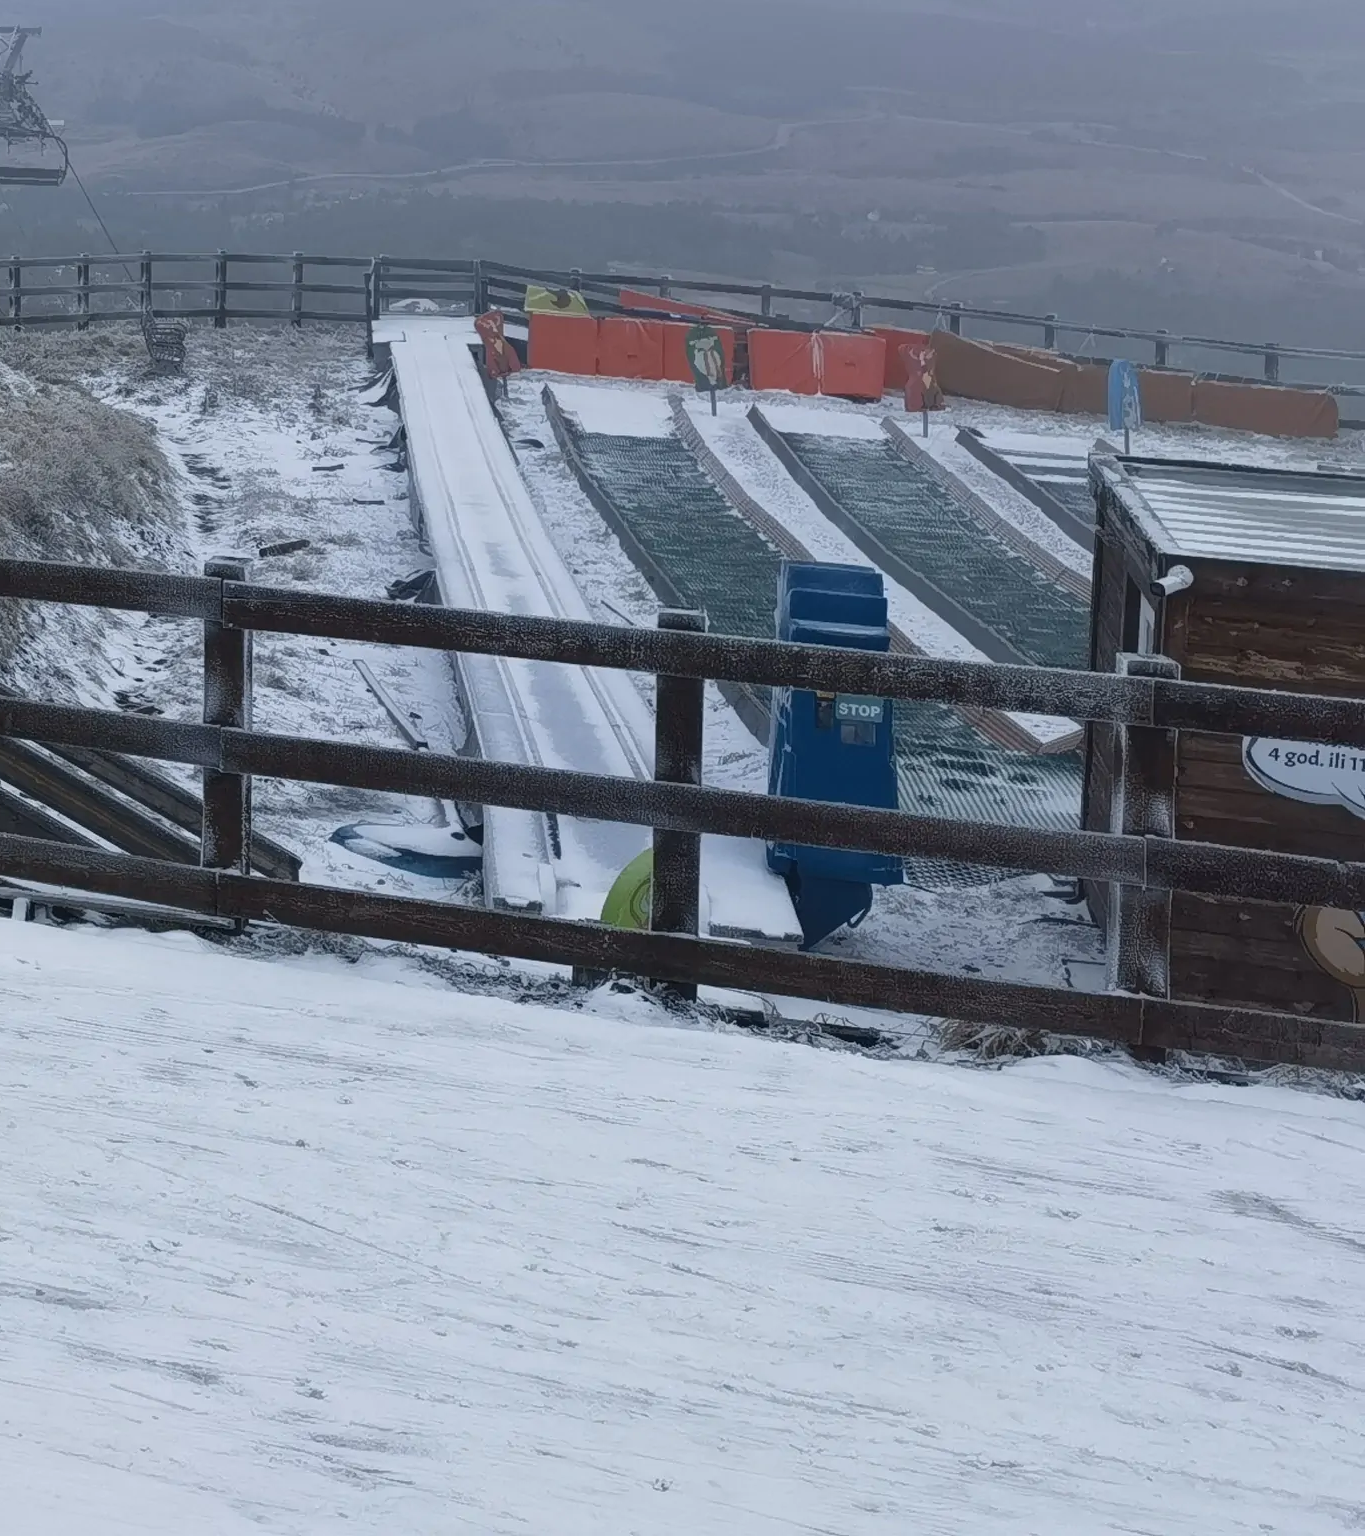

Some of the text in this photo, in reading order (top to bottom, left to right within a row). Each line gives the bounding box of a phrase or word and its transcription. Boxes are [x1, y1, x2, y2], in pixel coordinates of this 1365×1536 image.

[838, 702, 881, 717] STOP
[1268, 747, 1280, 761] 4
[1284, 749, 1324, 767] god.
[1329, 752, 1346, 769] ili
